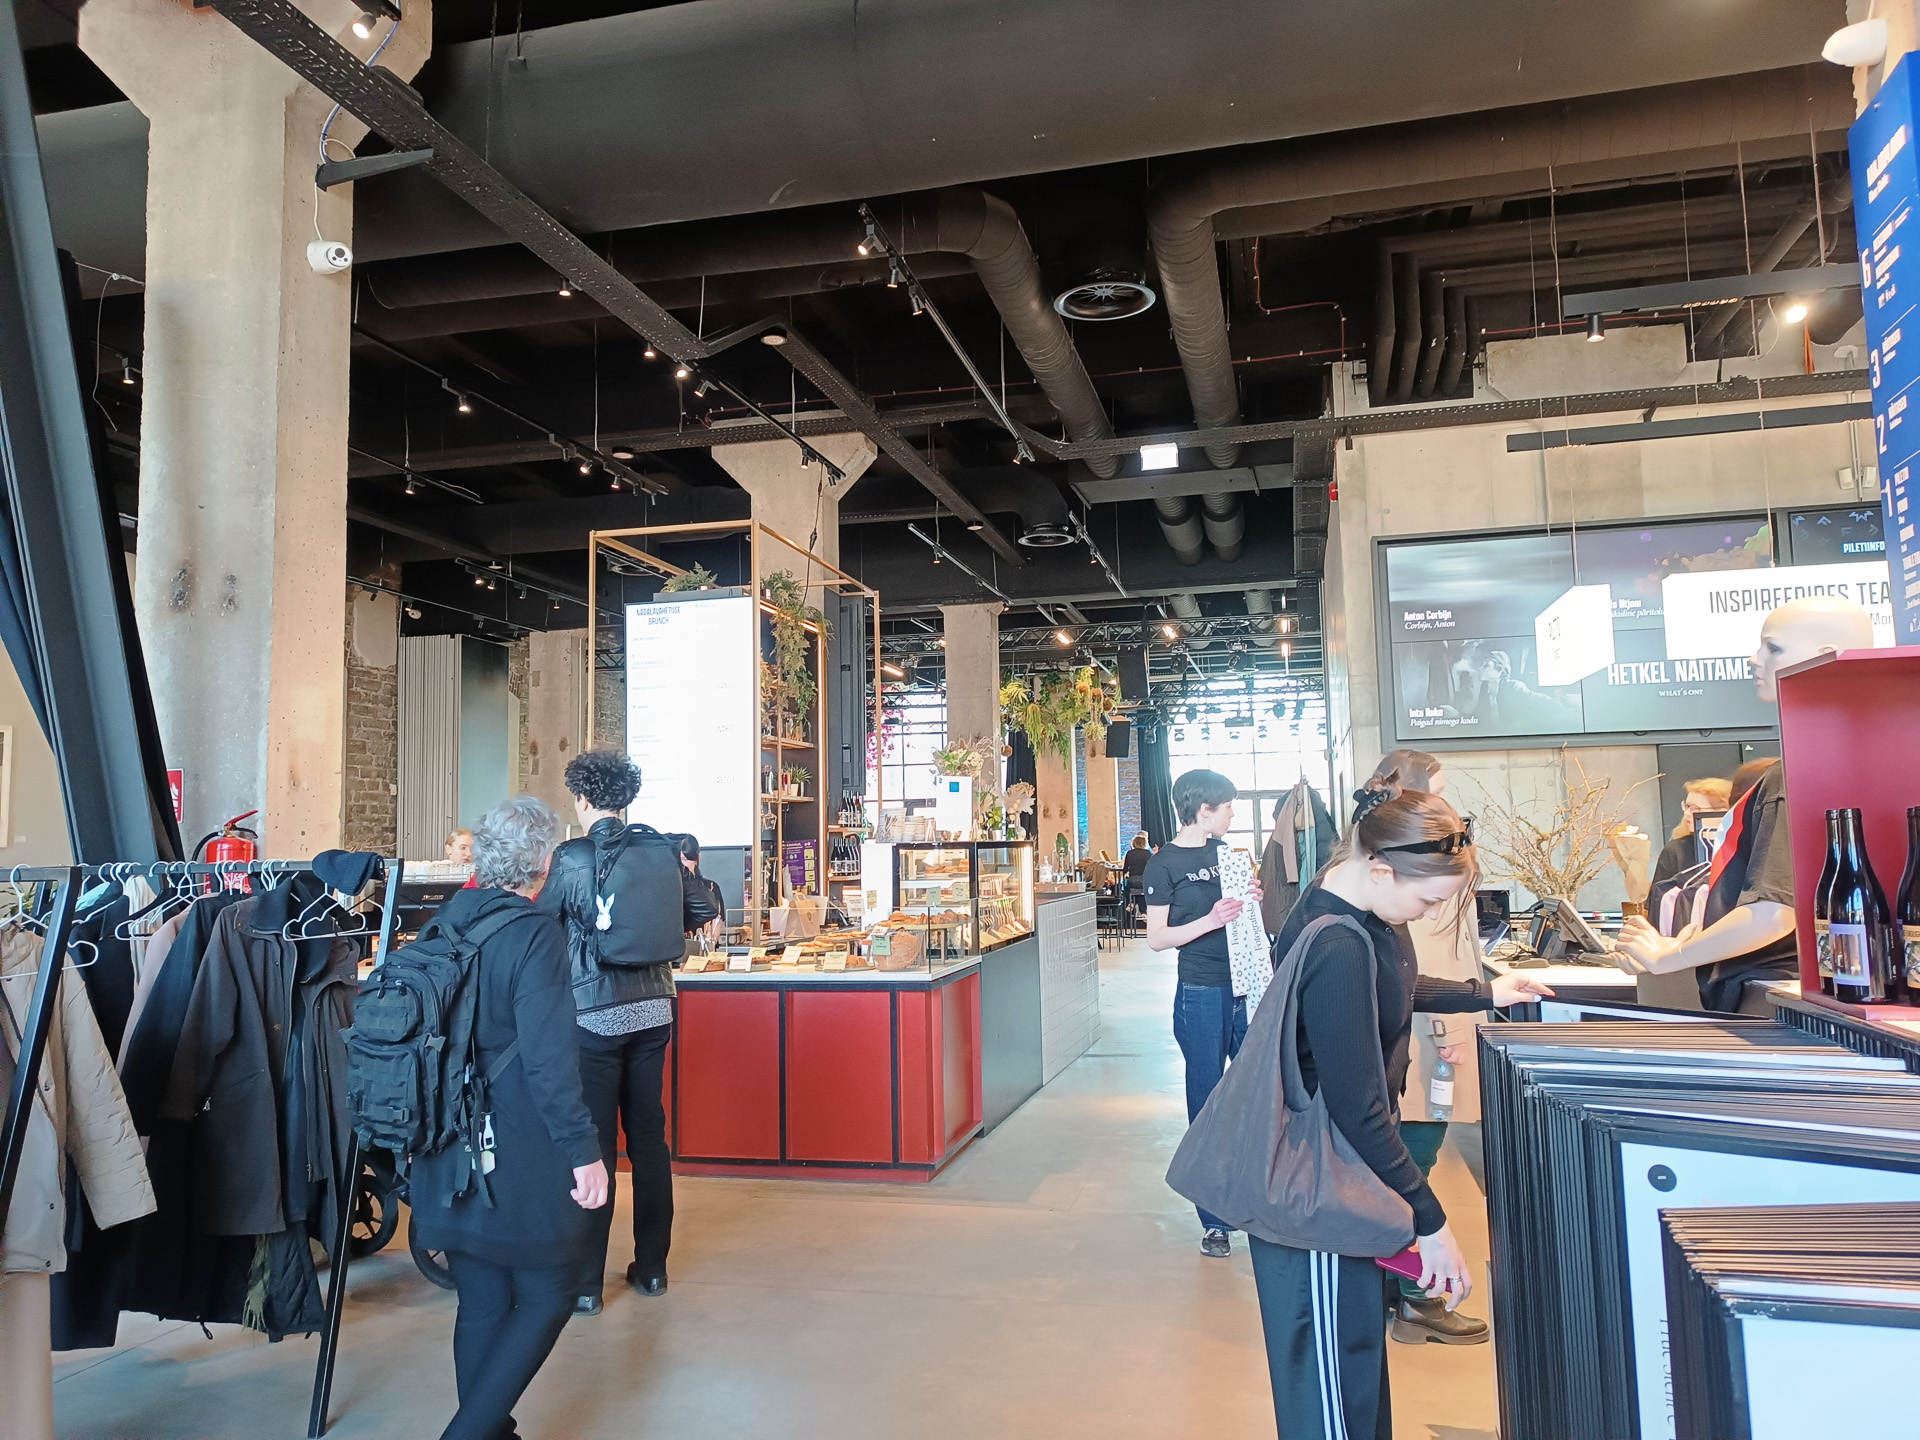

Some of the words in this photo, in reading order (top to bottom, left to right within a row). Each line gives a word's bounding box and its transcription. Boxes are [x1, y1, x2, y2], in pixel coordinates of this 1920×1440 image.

[1862, 248, 1872, 289] 6
[1869, 349, 1881, 389] 3
[1877, 414, 1887, 455] 2
[1880, 478, 1893, 517] 1
[1404, 611, 1425, 621] Anton
[1426, 609, 1452, 621] Corbijn
[1433, 620, 1456, 629] Anton
[1608, 661, 1670, 686] HETKEL
